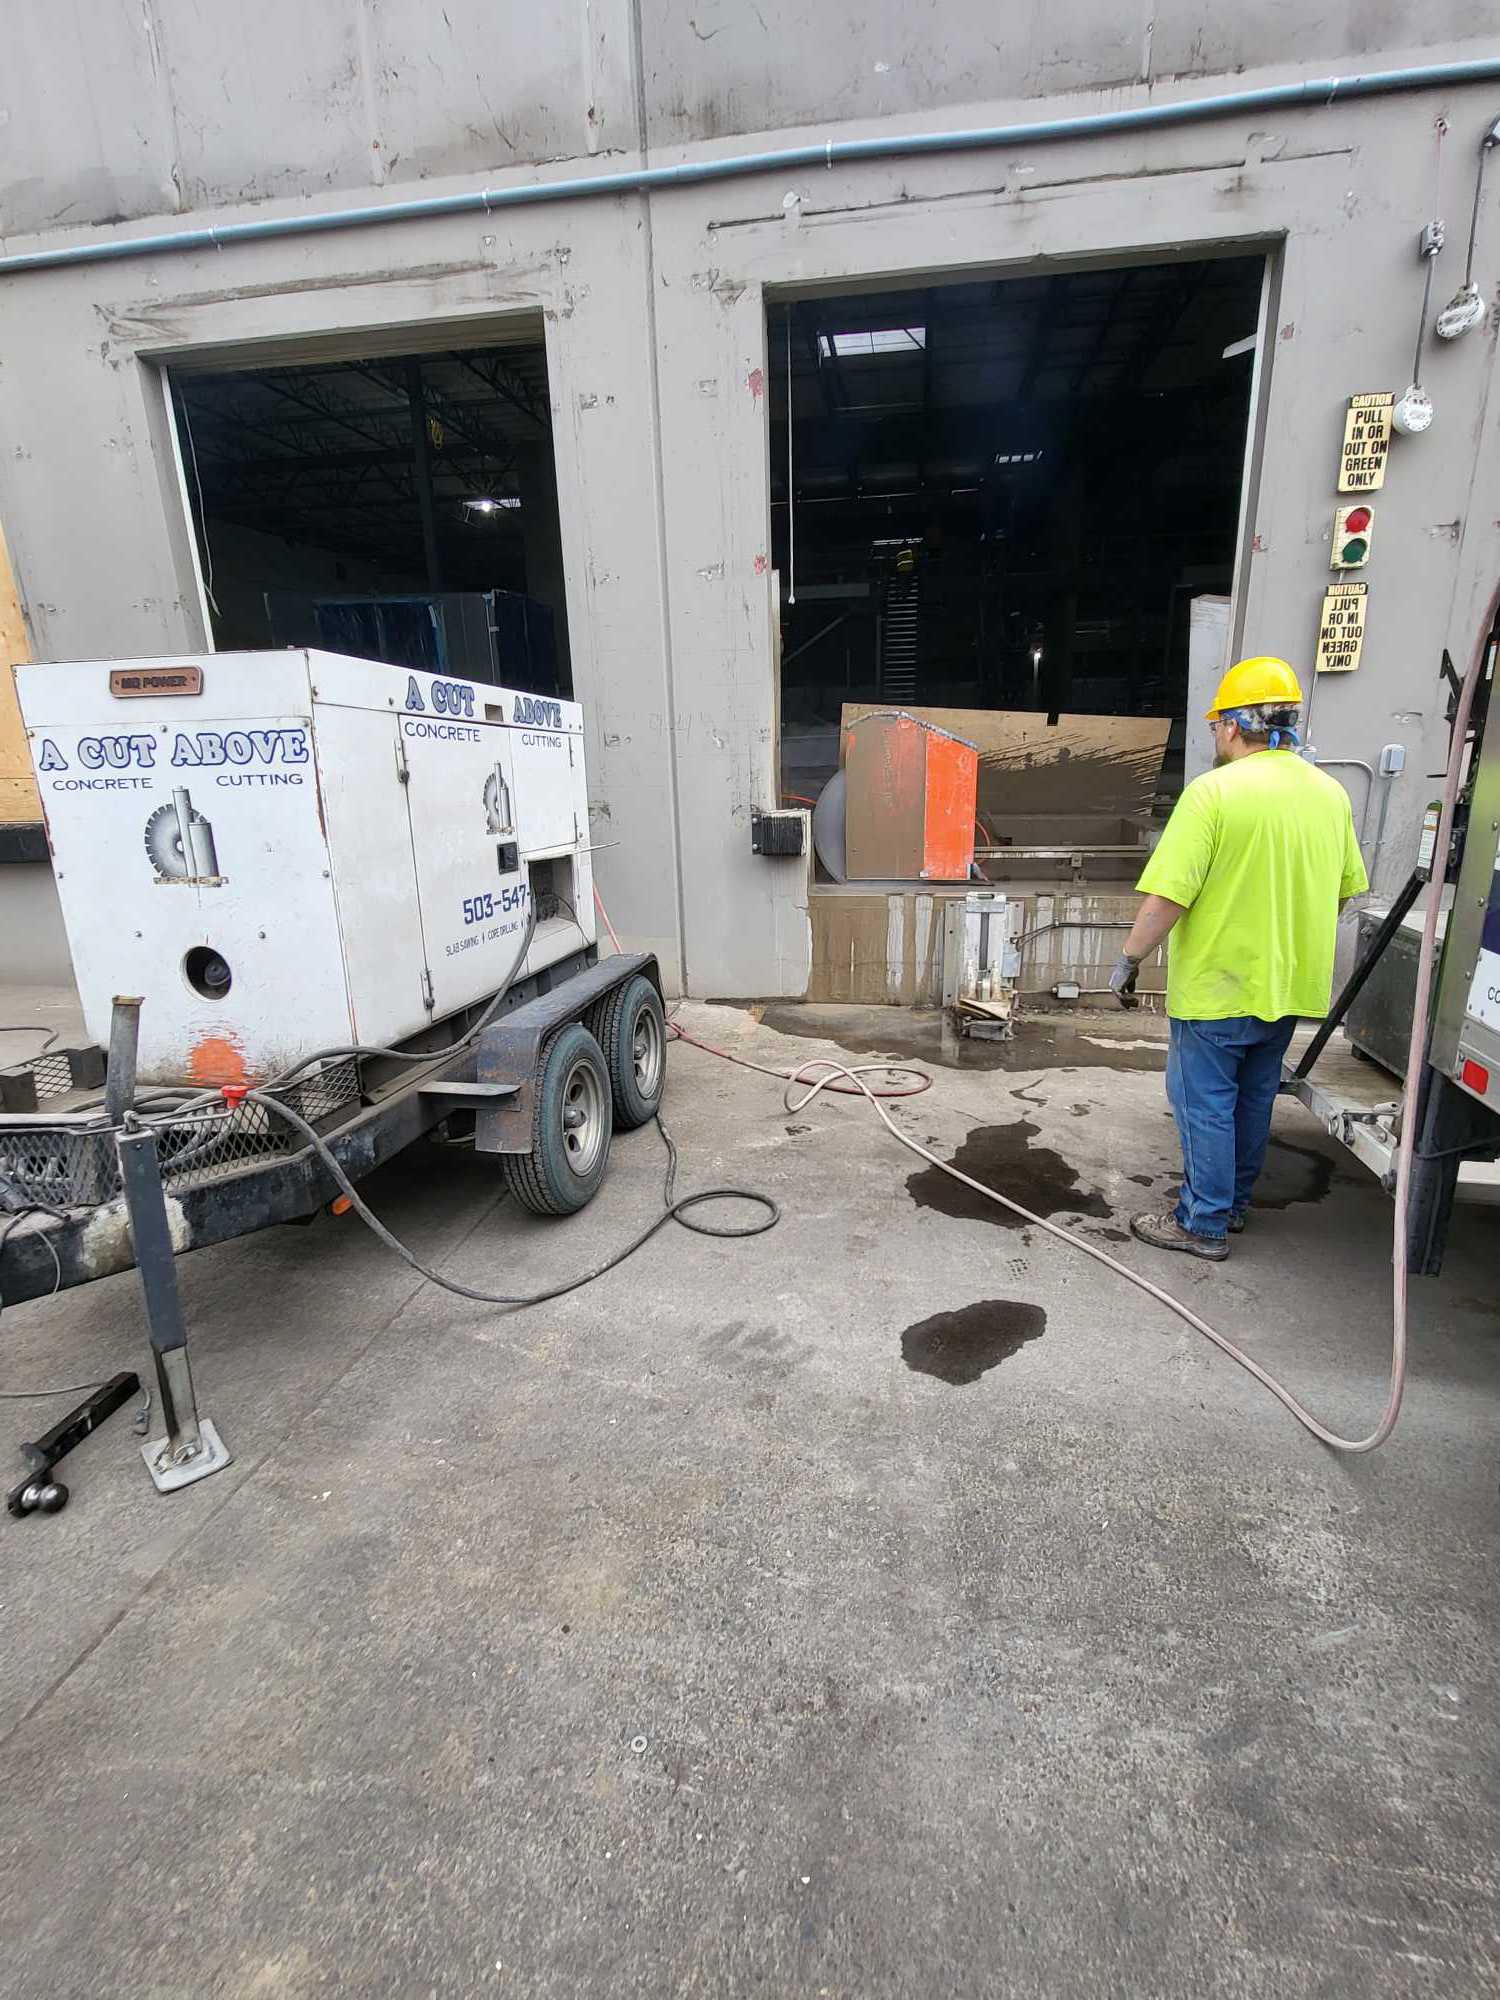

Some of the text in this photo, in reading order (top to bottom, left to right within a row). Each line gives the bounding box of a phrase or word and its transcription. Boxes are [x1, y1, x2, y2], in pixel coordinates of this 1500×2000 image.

[1351, 393, 1392, 407] CAUTION
[1355, 409, 1384, 424] PULL
[1351, 424, 1384, 441] IN OR
[1344, 439, 1388, 456] OUT ON
[1345, 456, 1383, 472] GREEN
[1347, 472, 1377, 487] ONLY
[142, 675, 187, 688] POWER
[404, 675, 563, 729] A CUT ABOVE
[403, 721, 563, 749] CONCRETE CUTTING
[39, 728, 310, 771] A CUT ABOVE
[52, 773, 304, 792] CONCRETE CUTTING
